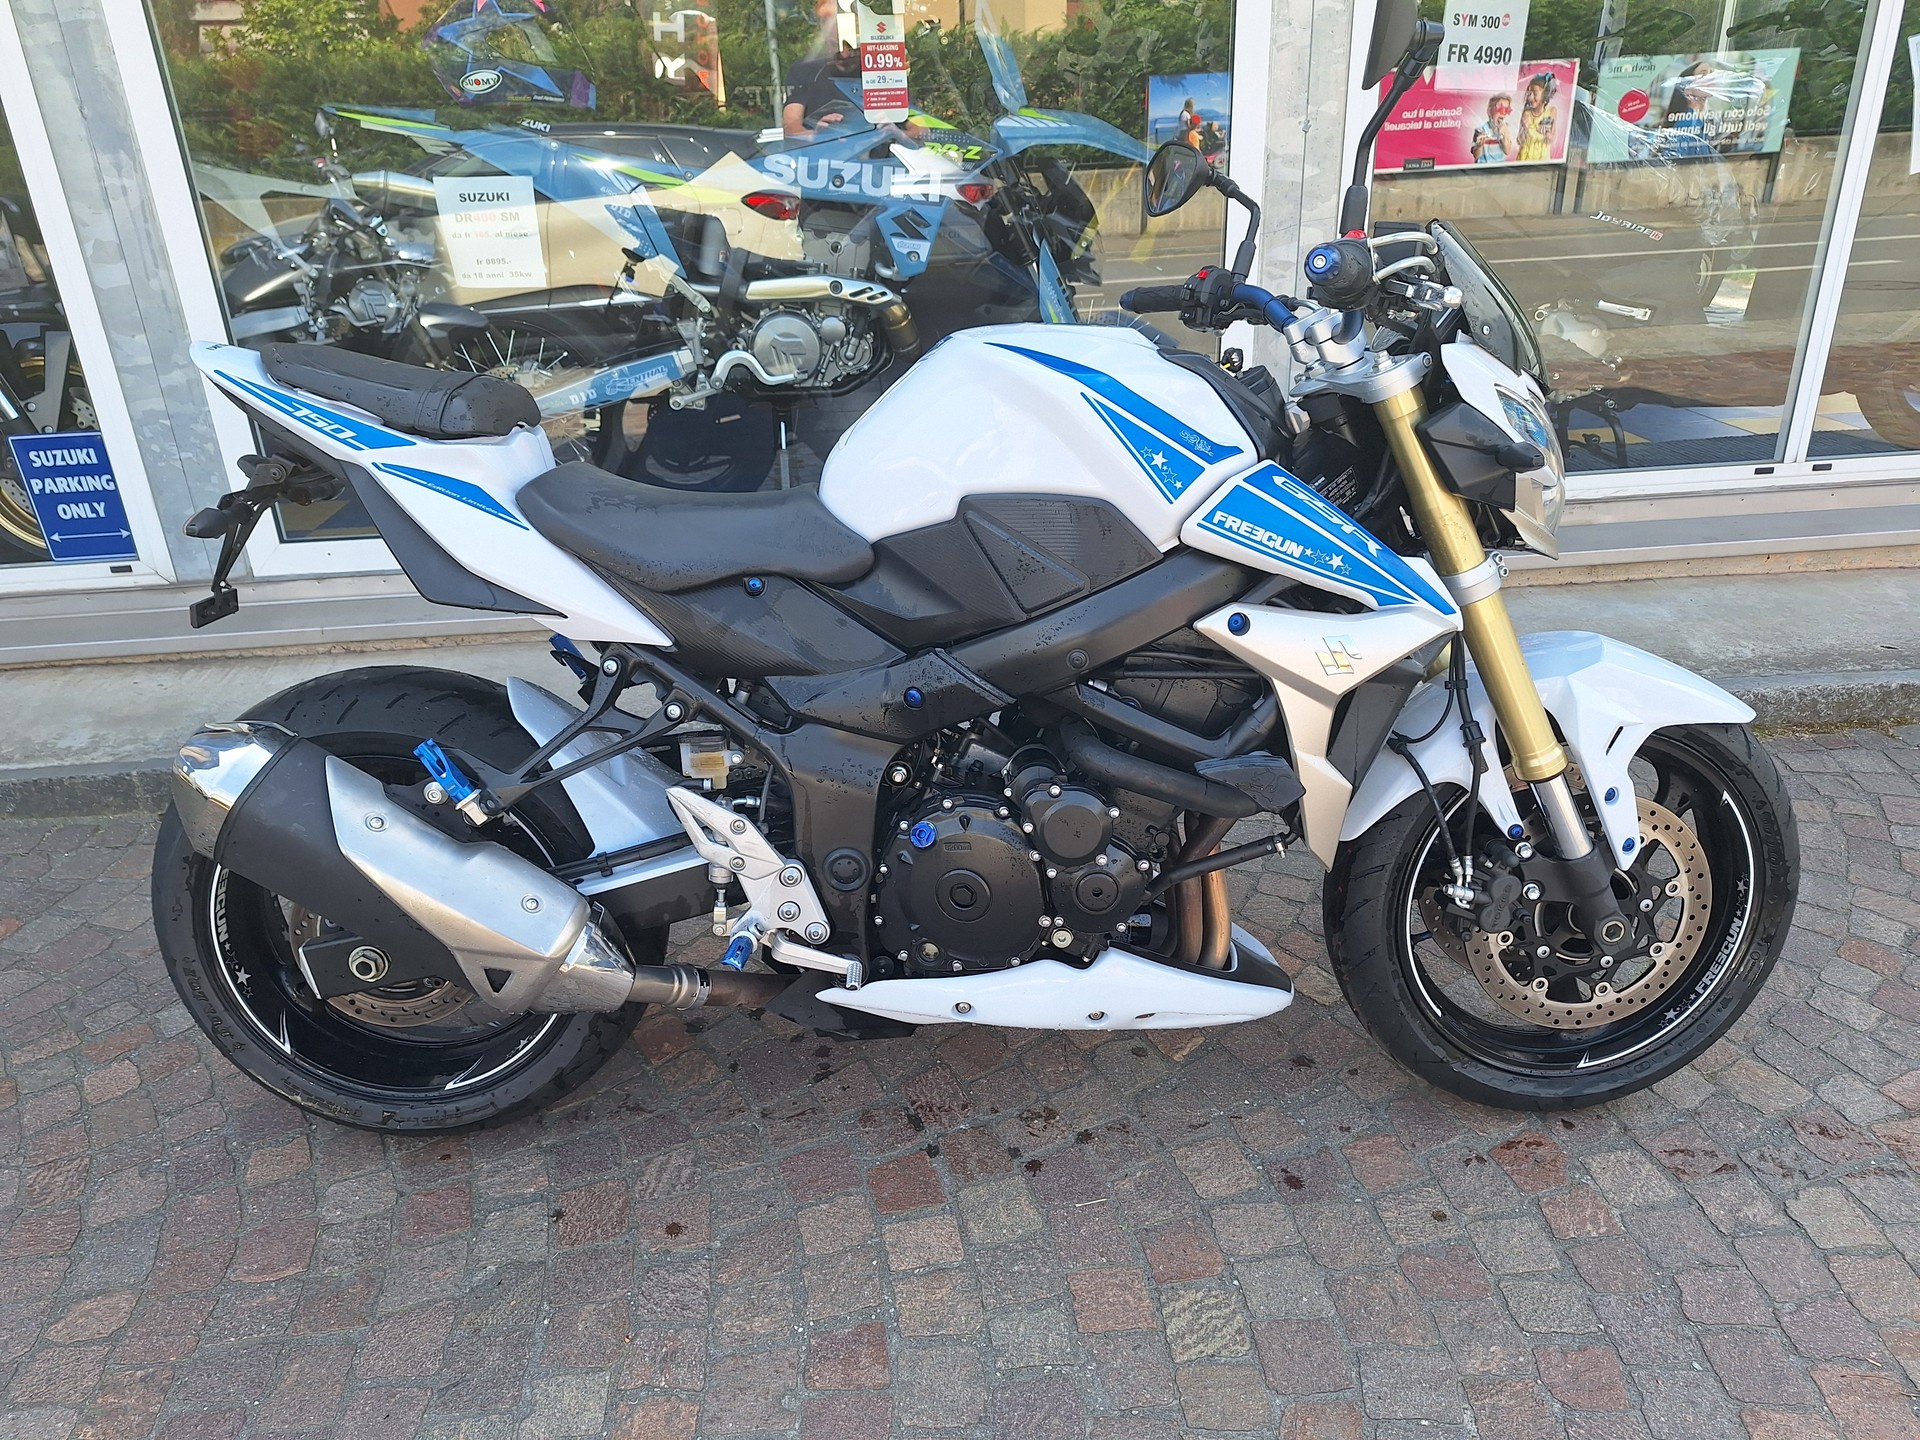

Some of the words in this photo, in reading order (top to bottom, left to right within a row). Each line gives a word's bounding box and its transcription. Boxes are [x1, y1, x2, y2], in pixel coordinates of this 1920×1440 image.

[1453, 13, 1478, 27] SYM
[1481, 15, 1500, 29] 300
[1447, 44, 1469, 63] FR
[1473, 45, 1512, 65] 4990
[464, 78, 498, 88] SUOMY
[763, 154, 942, 203] SUZUKI
[459, 192, 510, 203] SUZUKI
[455, 212, 496, 223] DR400
[501, 212, 520, 222] SM
[1590, 210, 1653, 236] JOYRIDE
[465, 231, 471, 239] fr
[486, 271, 504, 279] anni
[291, 401, 358, 439] 750
[29, 448, 98, 467] SUZUKI
[30, 474, 116, 494] PARKING
[57, 502, 105, 519] ONLY
[1212, 510, 1304, 559] FREEGUN
[1695, 917, 1743, 995] FREEGUN
